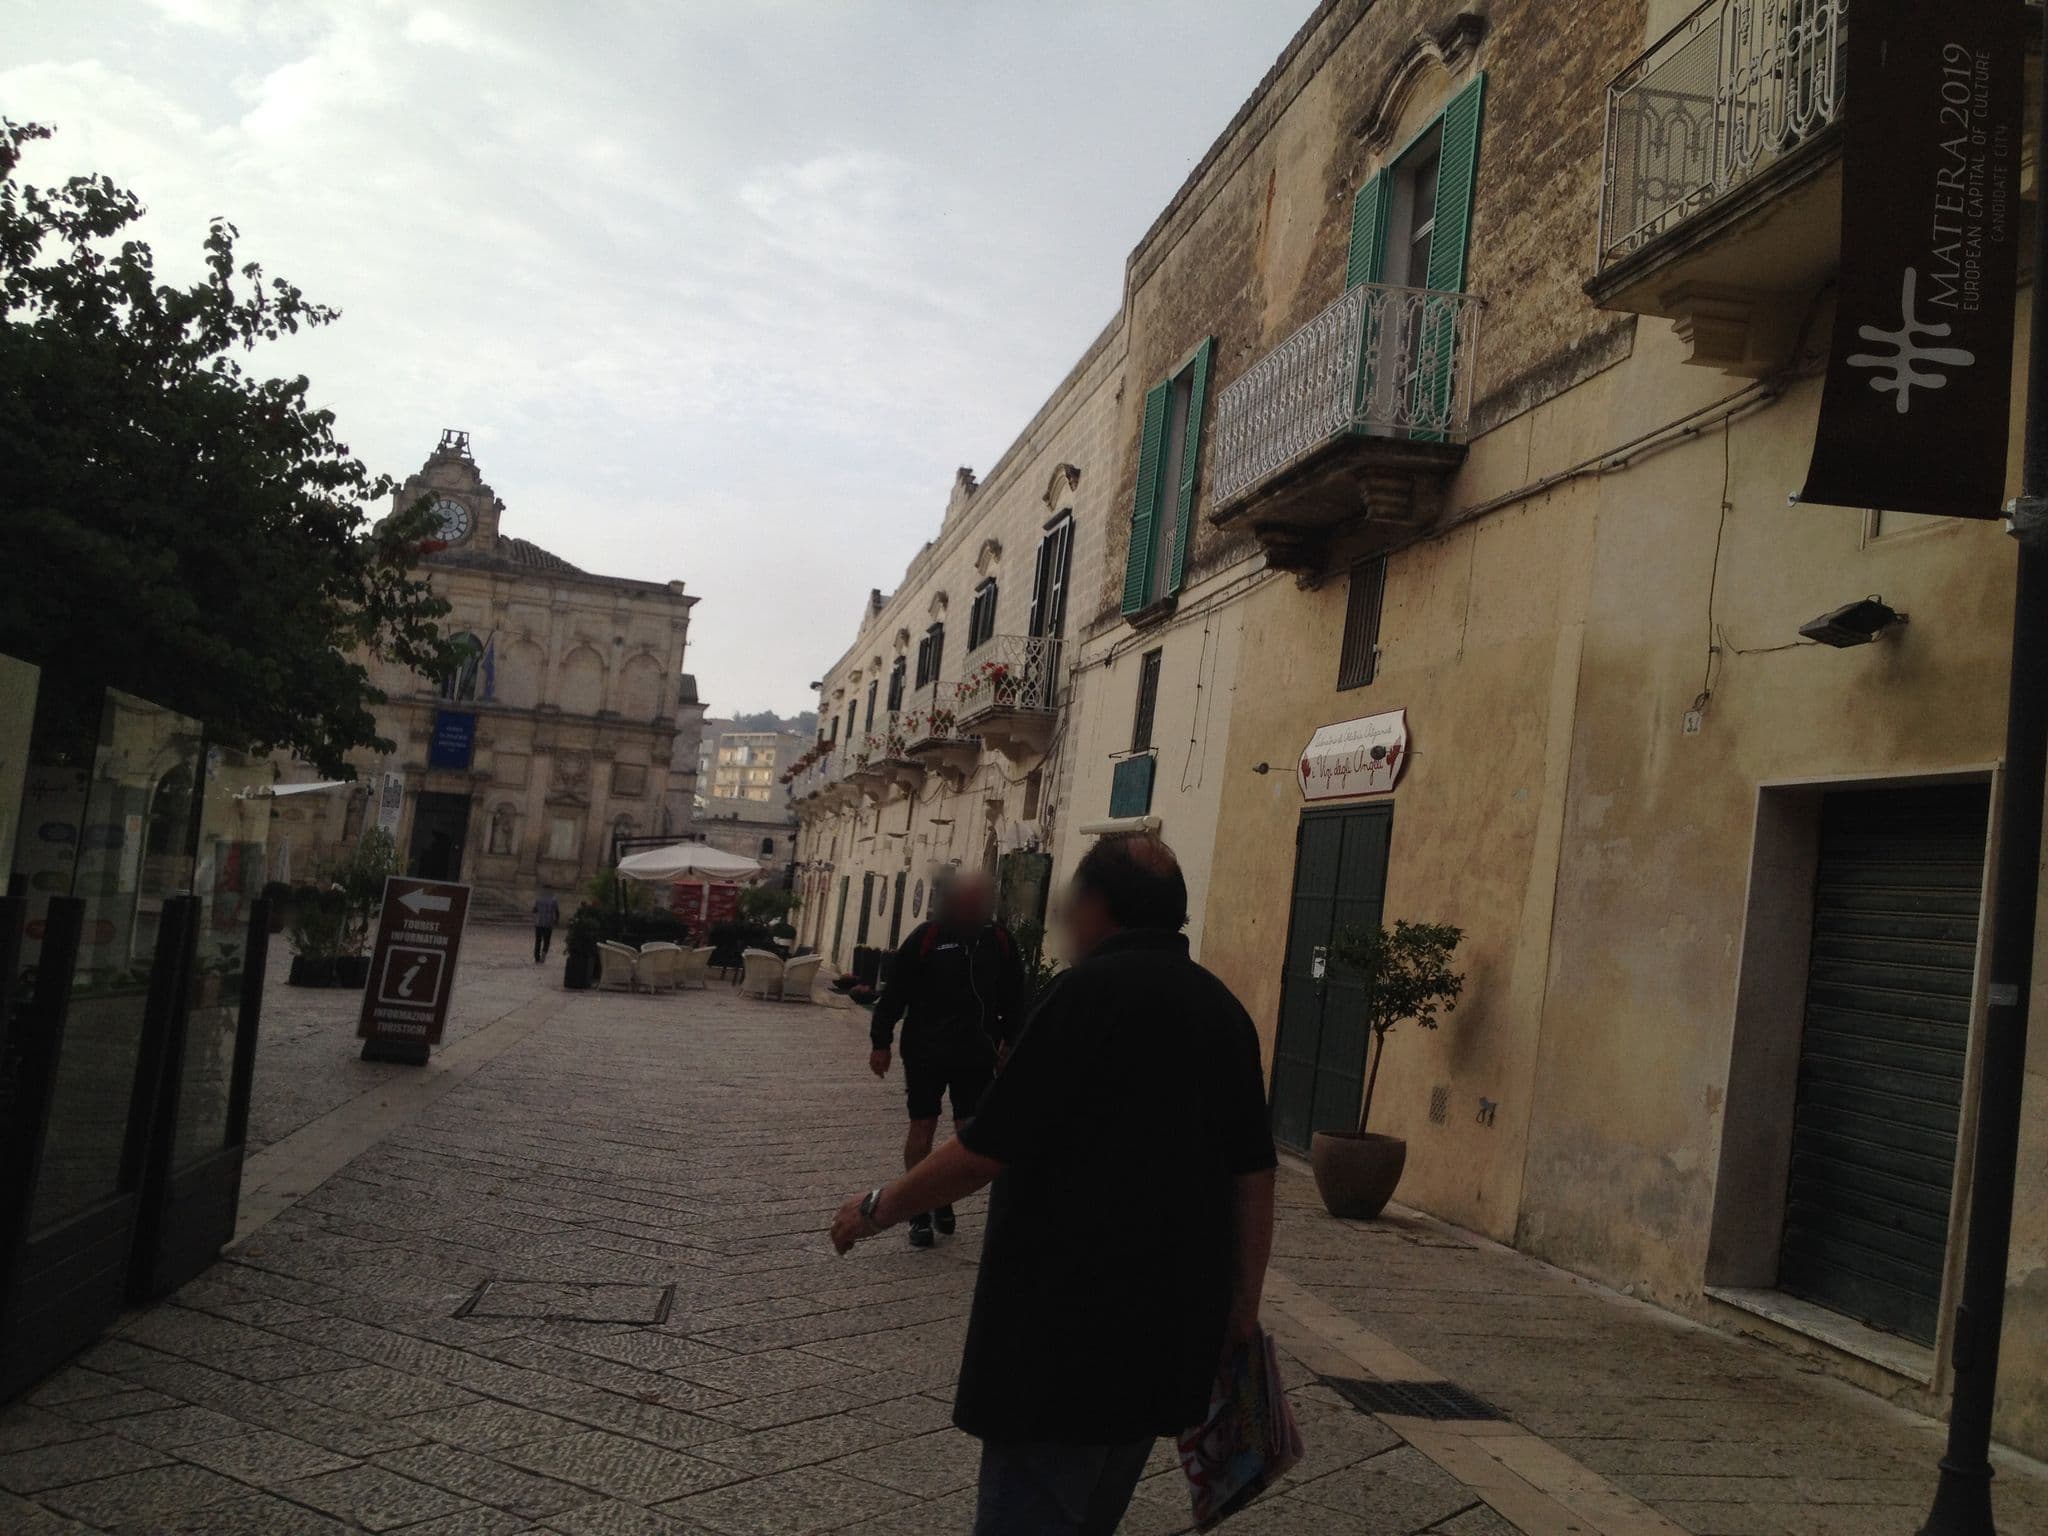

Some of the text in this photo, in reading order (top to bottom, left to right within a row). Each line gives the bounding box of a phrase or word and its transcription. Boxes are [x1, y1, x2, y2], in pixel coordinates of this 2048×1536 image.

[1928, 42, 1974, 311] MATERA 2019
[1963, 50, 1991, 312] EUROPEAN CAPITAL OF CULTURE
[1990, 123, 2009, 243] CANDIDATE CITY
[391, 931, 449, 945] INFORMATION
[404, 919, 440, 932] TOURIST
